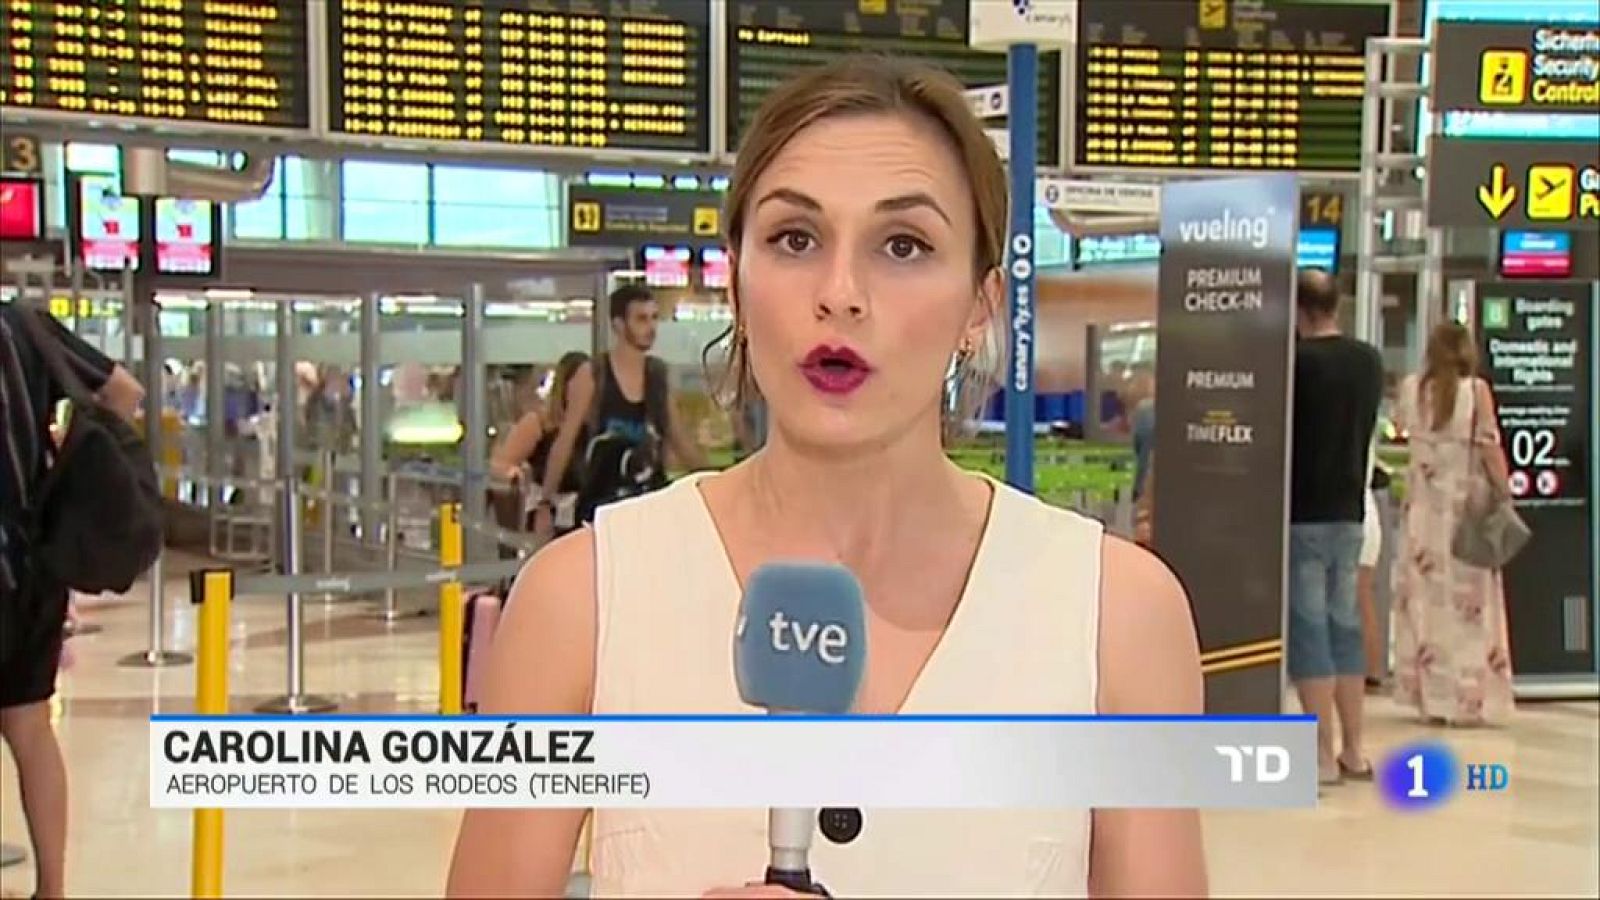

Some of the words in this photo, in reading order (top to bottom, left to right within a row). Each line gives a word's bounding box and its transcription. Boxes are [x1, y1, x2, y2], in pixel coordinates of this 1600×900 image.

[1534, 54, 1600, 80] Security
[11, 138, 36, 171] 3
[1307, 195, 1341, 223] 14
[1179, 208, 1269, 248] vueling
[1186, 267, 1262, 288] PREMIUM
[1184, 291, 1262, 312] CHECK-IN
[1187, 371, 1254, 389] PREMIUM
[1512, 429, 1555, 466] 02
[769, 611, 848, 663] tve
